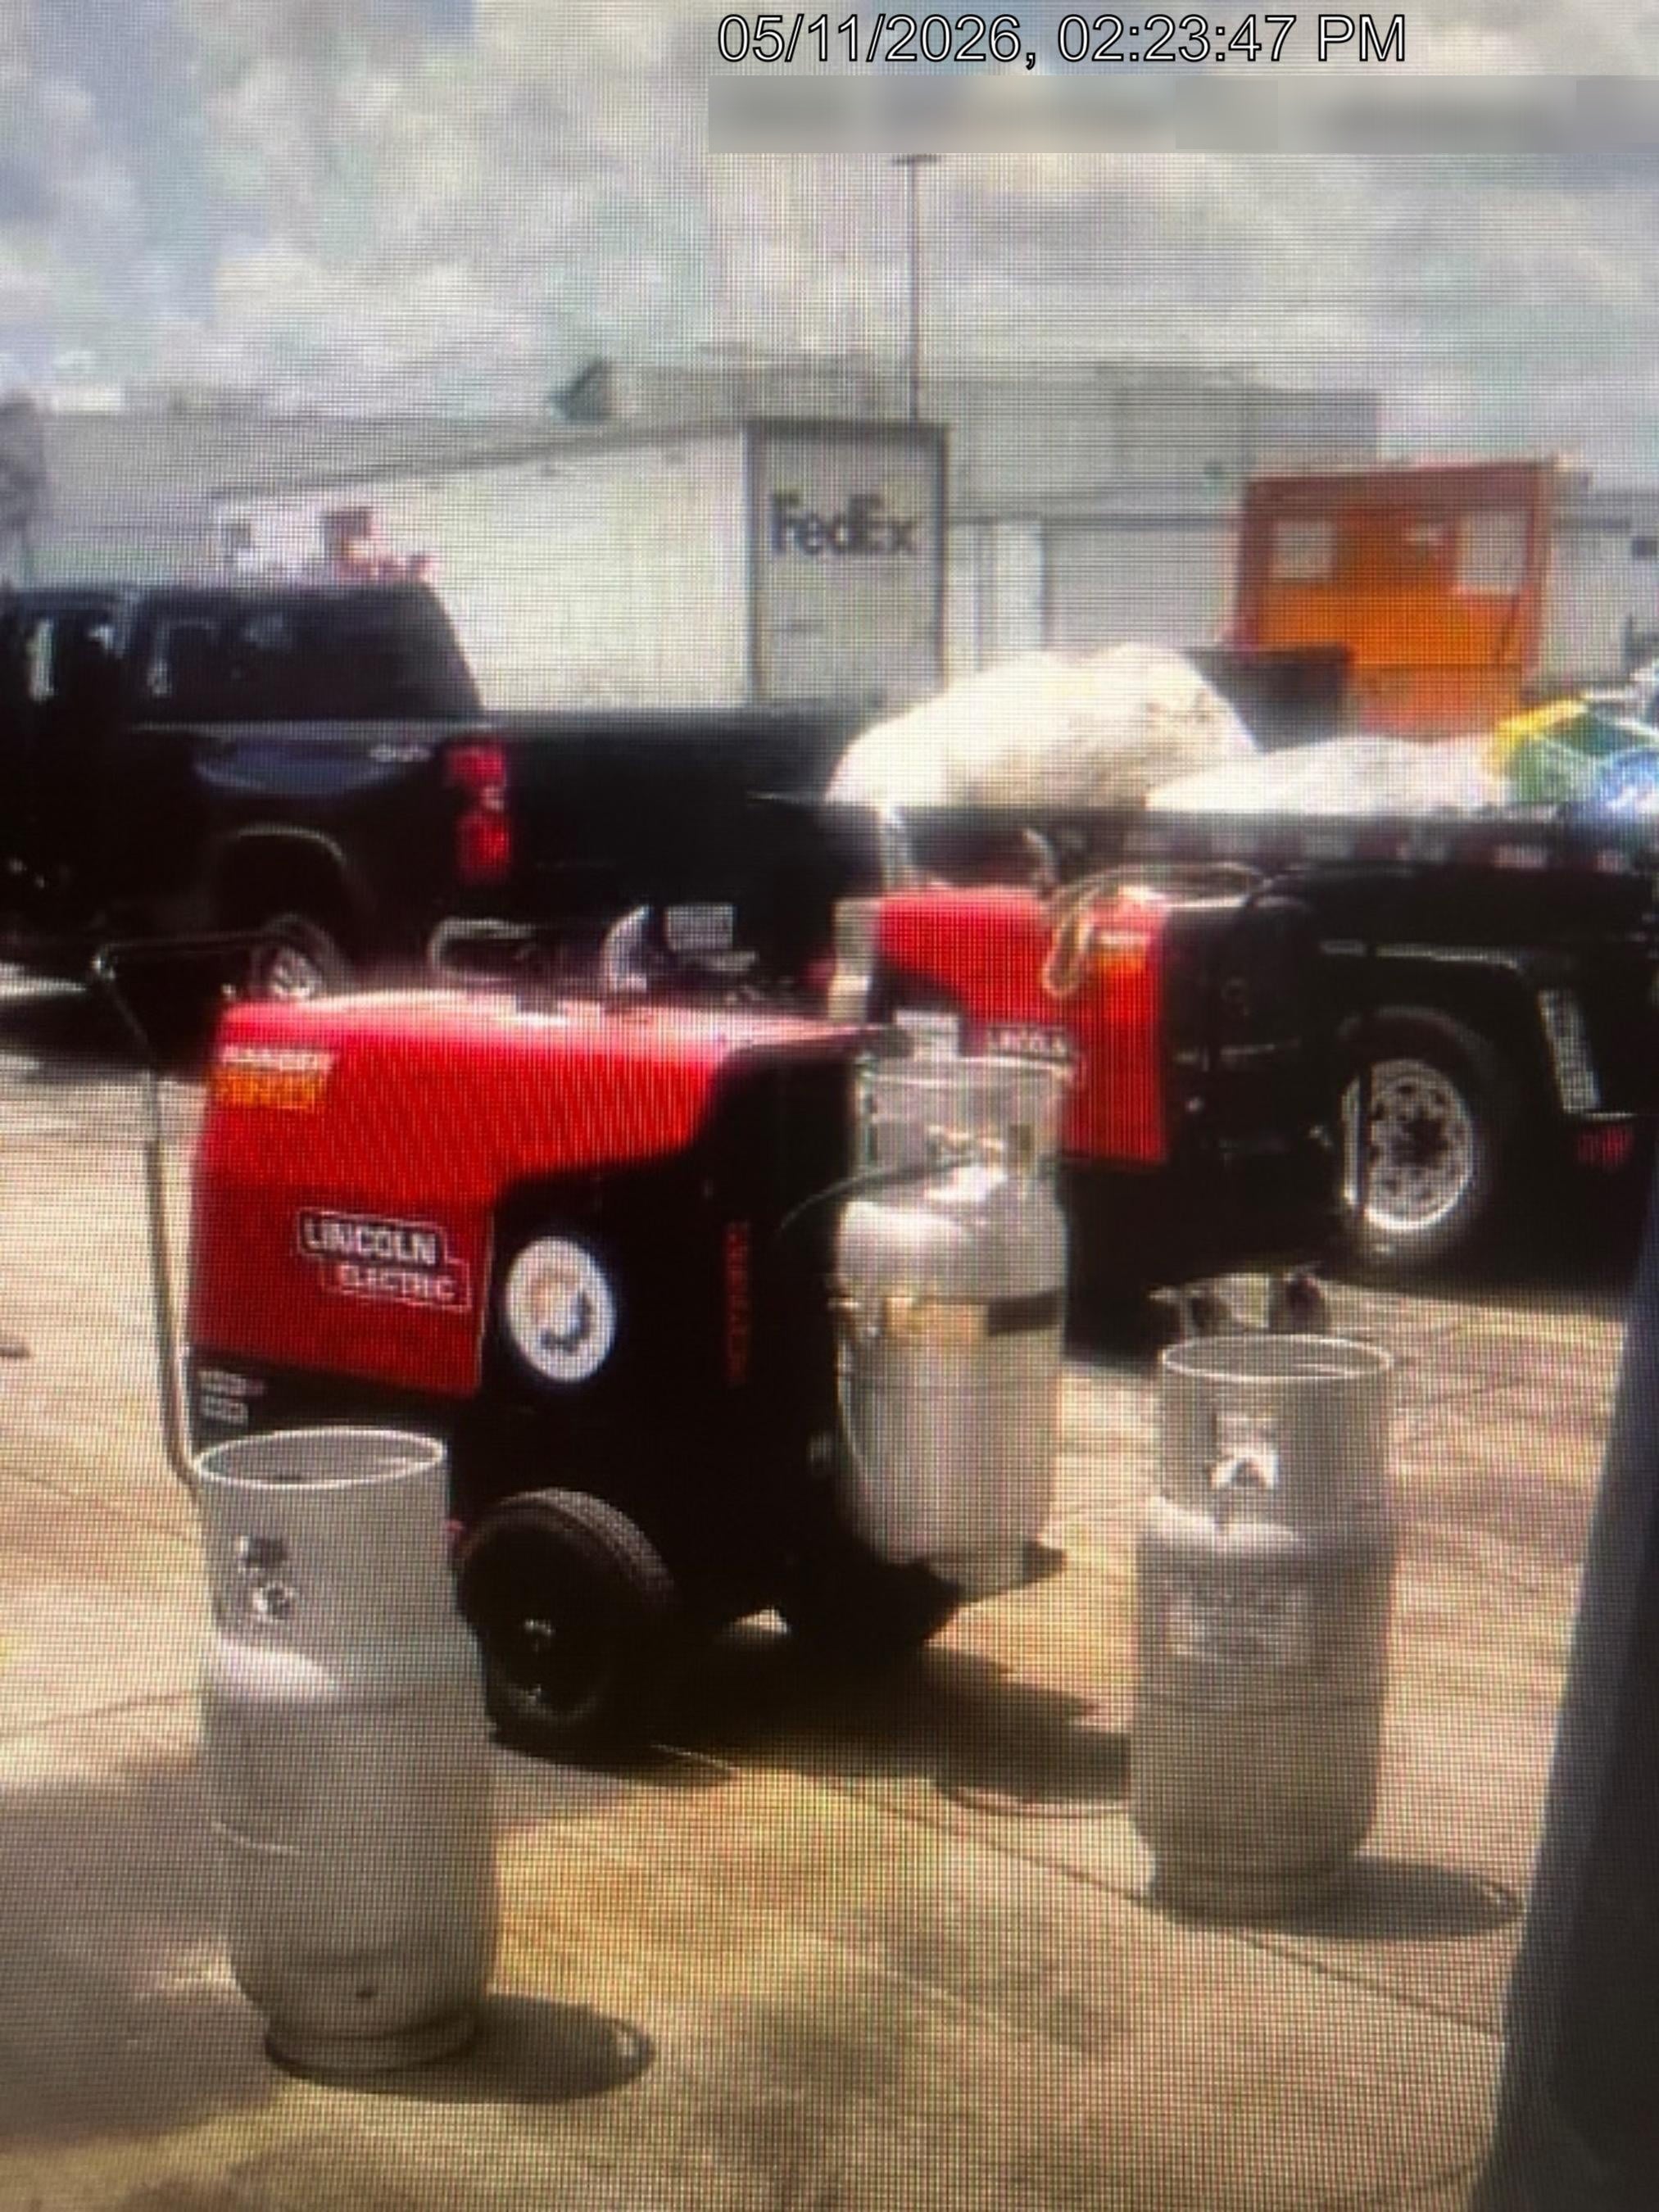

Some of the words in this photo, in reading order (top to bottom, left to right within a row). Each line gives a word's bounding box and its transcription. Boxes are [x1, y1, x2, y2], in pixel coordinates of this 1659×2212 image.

[772, 492, 918, 556] FedEx
[302, 1215, 437, 1267] LINCOLN
[337, 1262, 456, 1303] ELECTRIC
